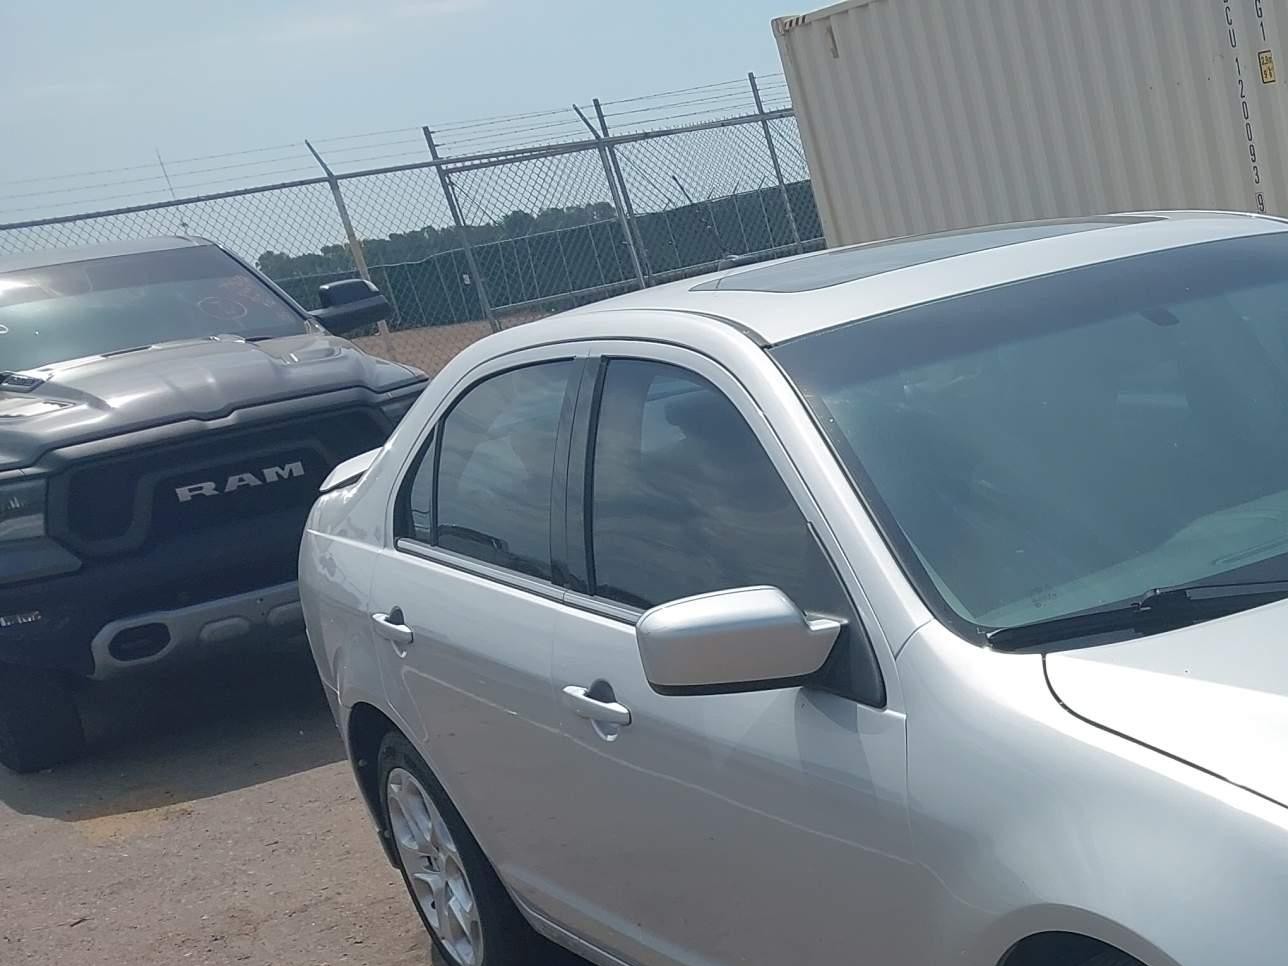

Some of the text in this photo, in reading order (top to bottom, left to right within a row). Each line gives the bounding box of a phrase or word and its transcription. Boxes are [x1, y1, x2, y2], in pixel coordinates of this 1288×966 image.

[1223, 0, 1265, 212] CU 120093 9
[175, 461, 305, 502] RAM
